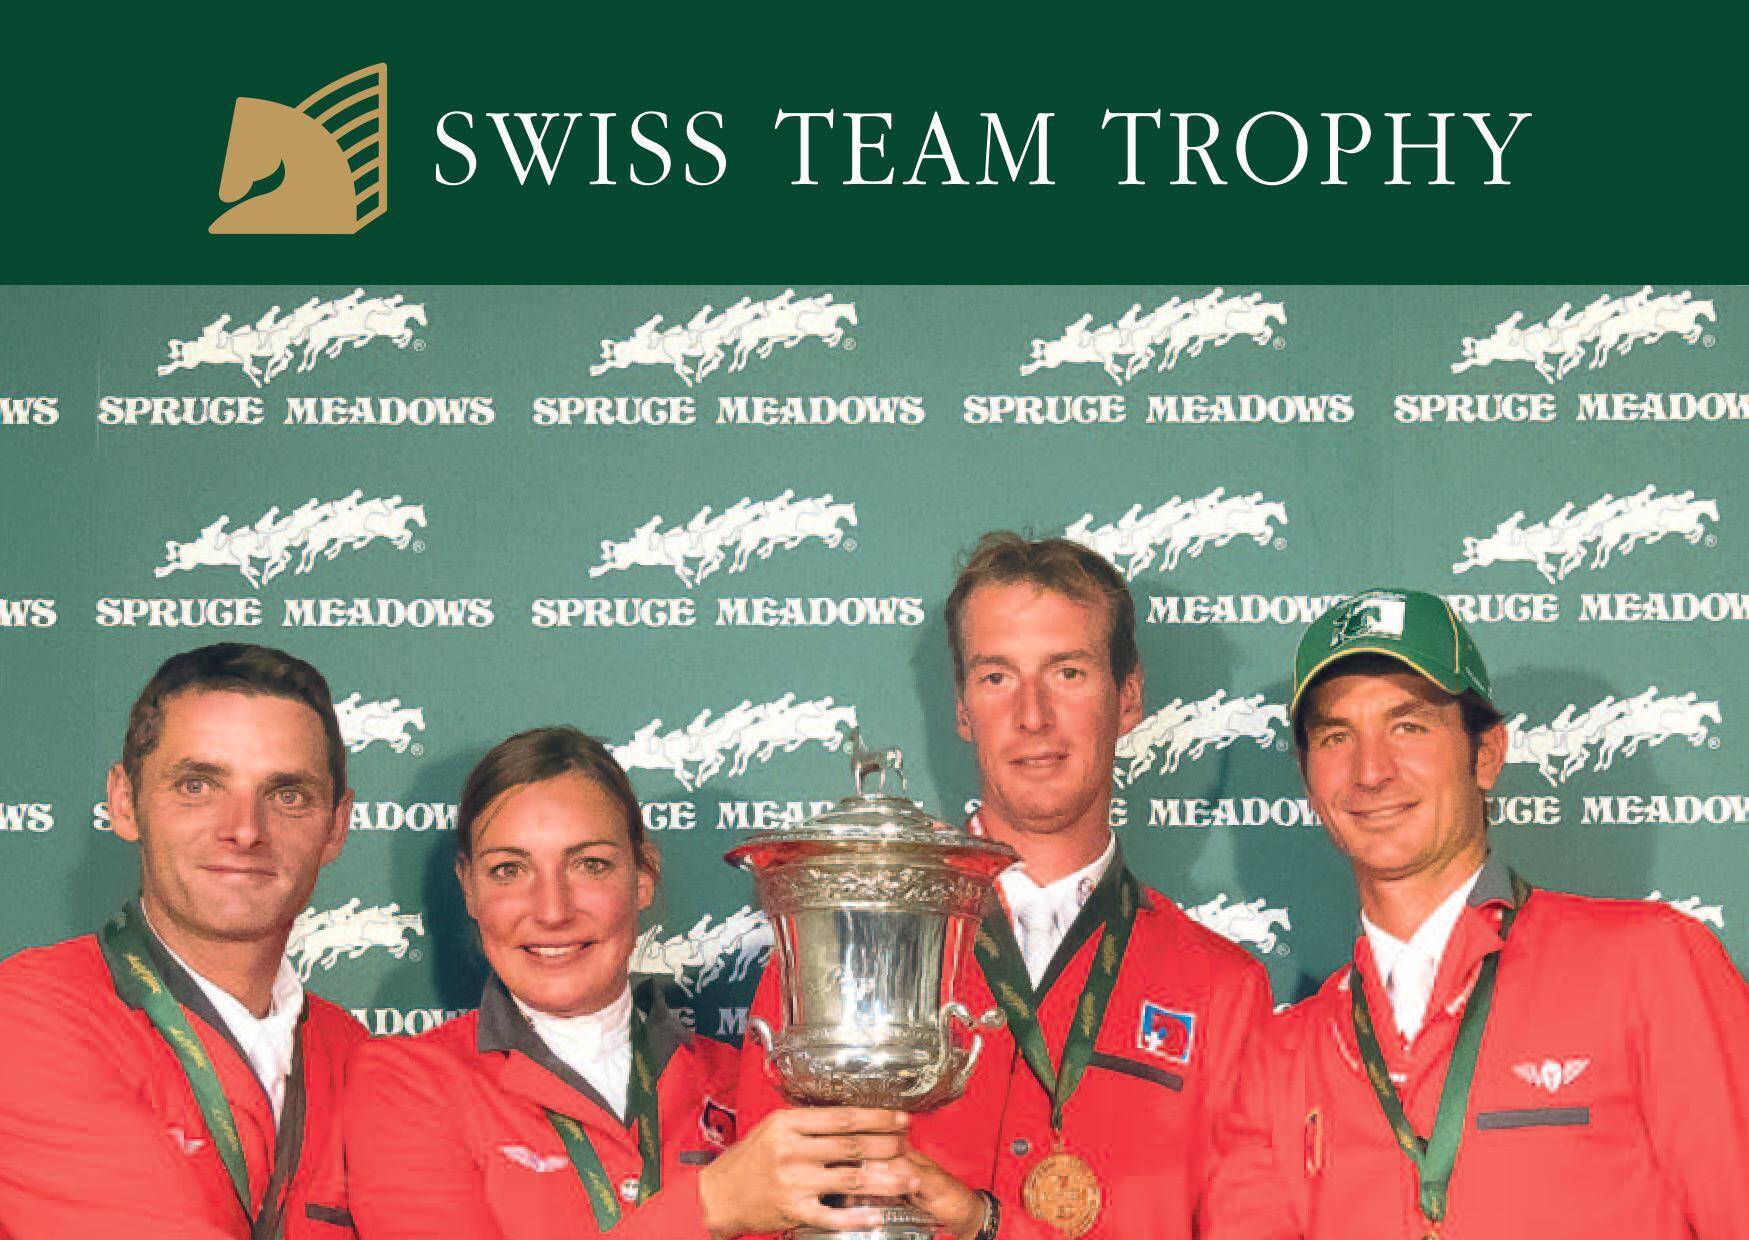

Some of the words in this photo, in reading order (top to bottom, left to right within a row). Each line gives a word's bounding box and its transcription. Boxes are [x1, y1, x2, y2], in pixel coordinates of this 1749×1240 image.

[97, 396, 265, 426] SPRUCE
[283, 396, 495, 426] MEADOWS
[532, 396, 697, 426] SPRUCE
[715, 396, 926, 426] MEADOWS
[963, 394, 1127, 425] SPRUCE
[1145, 393, 1355, 424] MEADOWS
[1393, 392, 1557, 424] SPRUCE
[95, 598, 263, 628] SPRUCE
[281, 597, 495, 628] MEADOWS
[531, 596, 697, 628] SPRUCE
[715, 596, 925, 627] MEADOWS
[1145, 592, 1350, 625] MEADOW
